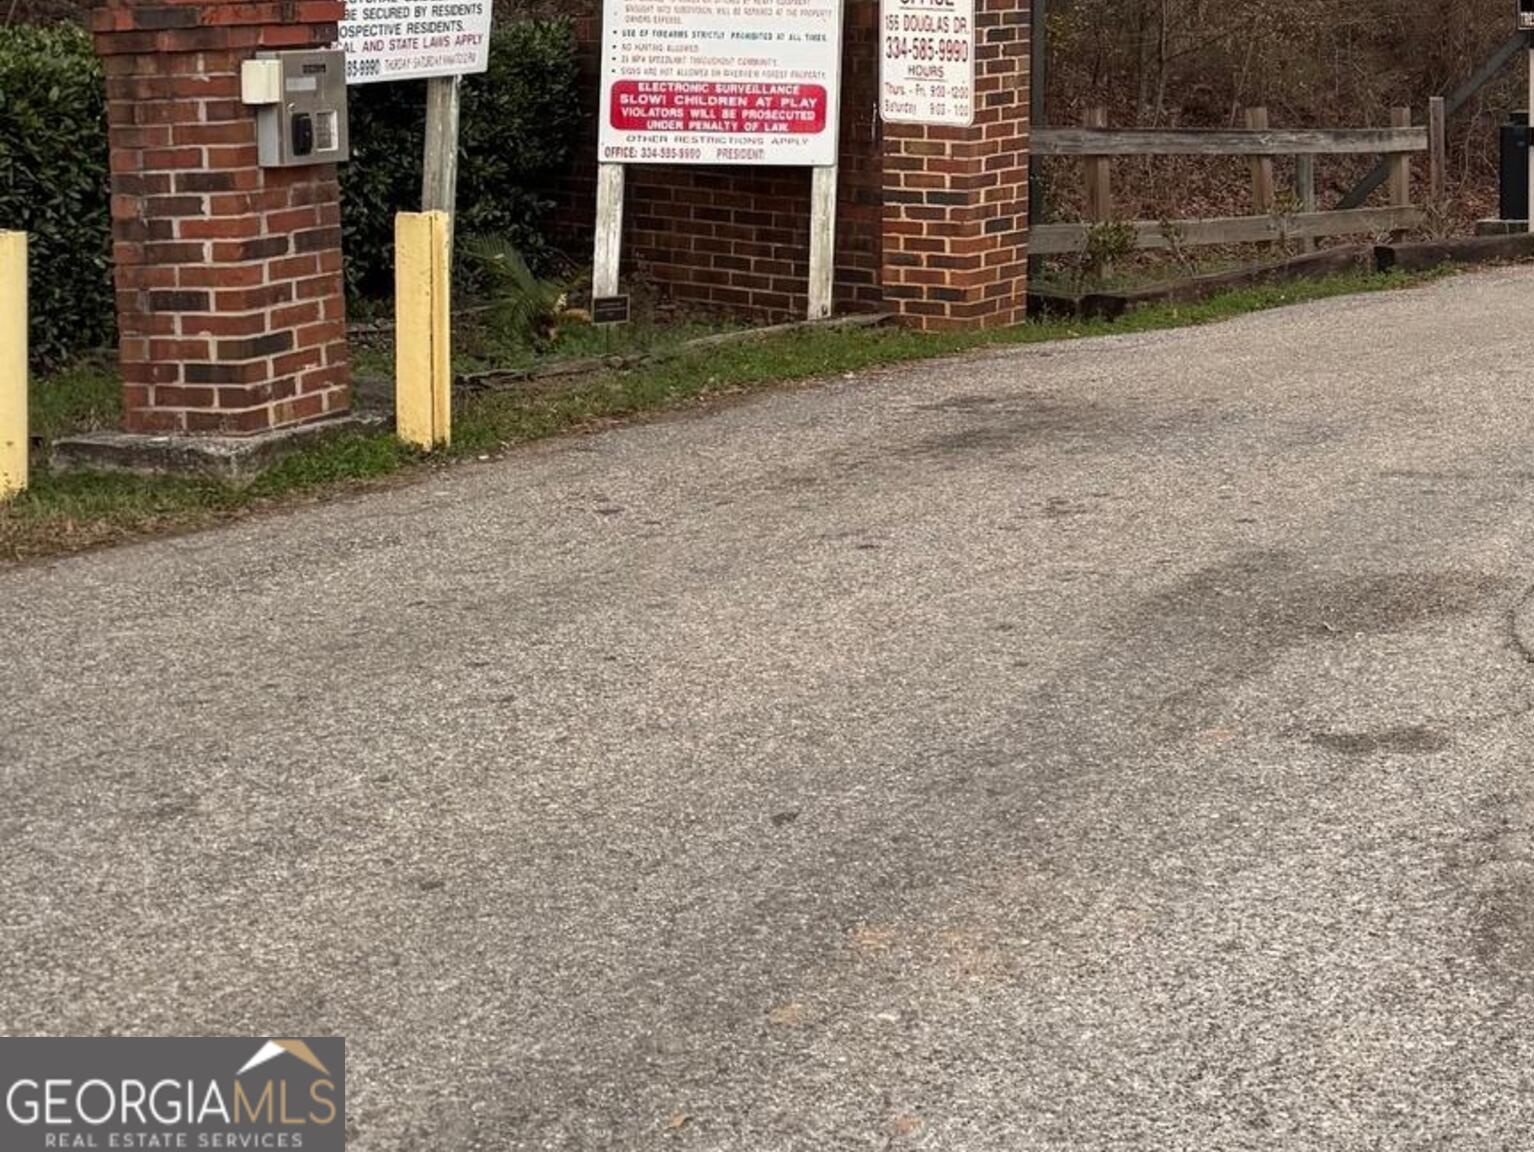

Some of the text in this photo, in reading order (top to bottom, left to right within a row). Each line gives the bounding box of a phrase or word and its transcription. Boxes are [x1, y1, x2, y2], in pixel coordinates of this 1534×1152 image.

[362, 6, 410, 20] SECURED
[414, 6, 428, 18] BY
[432, 4, 483, 17] RESIDENTS
[339, 20, 465, 38] OSPECTIVE RESIDENTS.
[903, 14, 950, 33] DOUGLAS
[652, 30, 688, 38] FIREARMS
[691, 30, 725, 39] STRICTLY
[730, 32, 773, 41] PROHIBITED
[362, 39, 384, 53] AND
[389, 38, 418, 51] STATE
[423, 36, 450, 49] LAWS
[455, 34, 483, 46] APPLY
[886, 36, 969, 62] 334-585-9990
[908, 64, 945, 79] HOURS
[638, 82, 800, 95] ELECTRONIC SURVEILLANCE
[620, 95, 817, 109] SLOW! CHILDREN AT PLAY
[621, 107, 816, 121] VIOLATORS WILL BE PROSECUTED
[647, 120, 684, 130] UNDER
[688, 120, 738, 131] PENALTY
[744, 121, 758, 131] OF
[626, 134, 809, 146] OTHER RESTRICTIONS APPLY
[604, 146, 637, 159] OFFICE:
